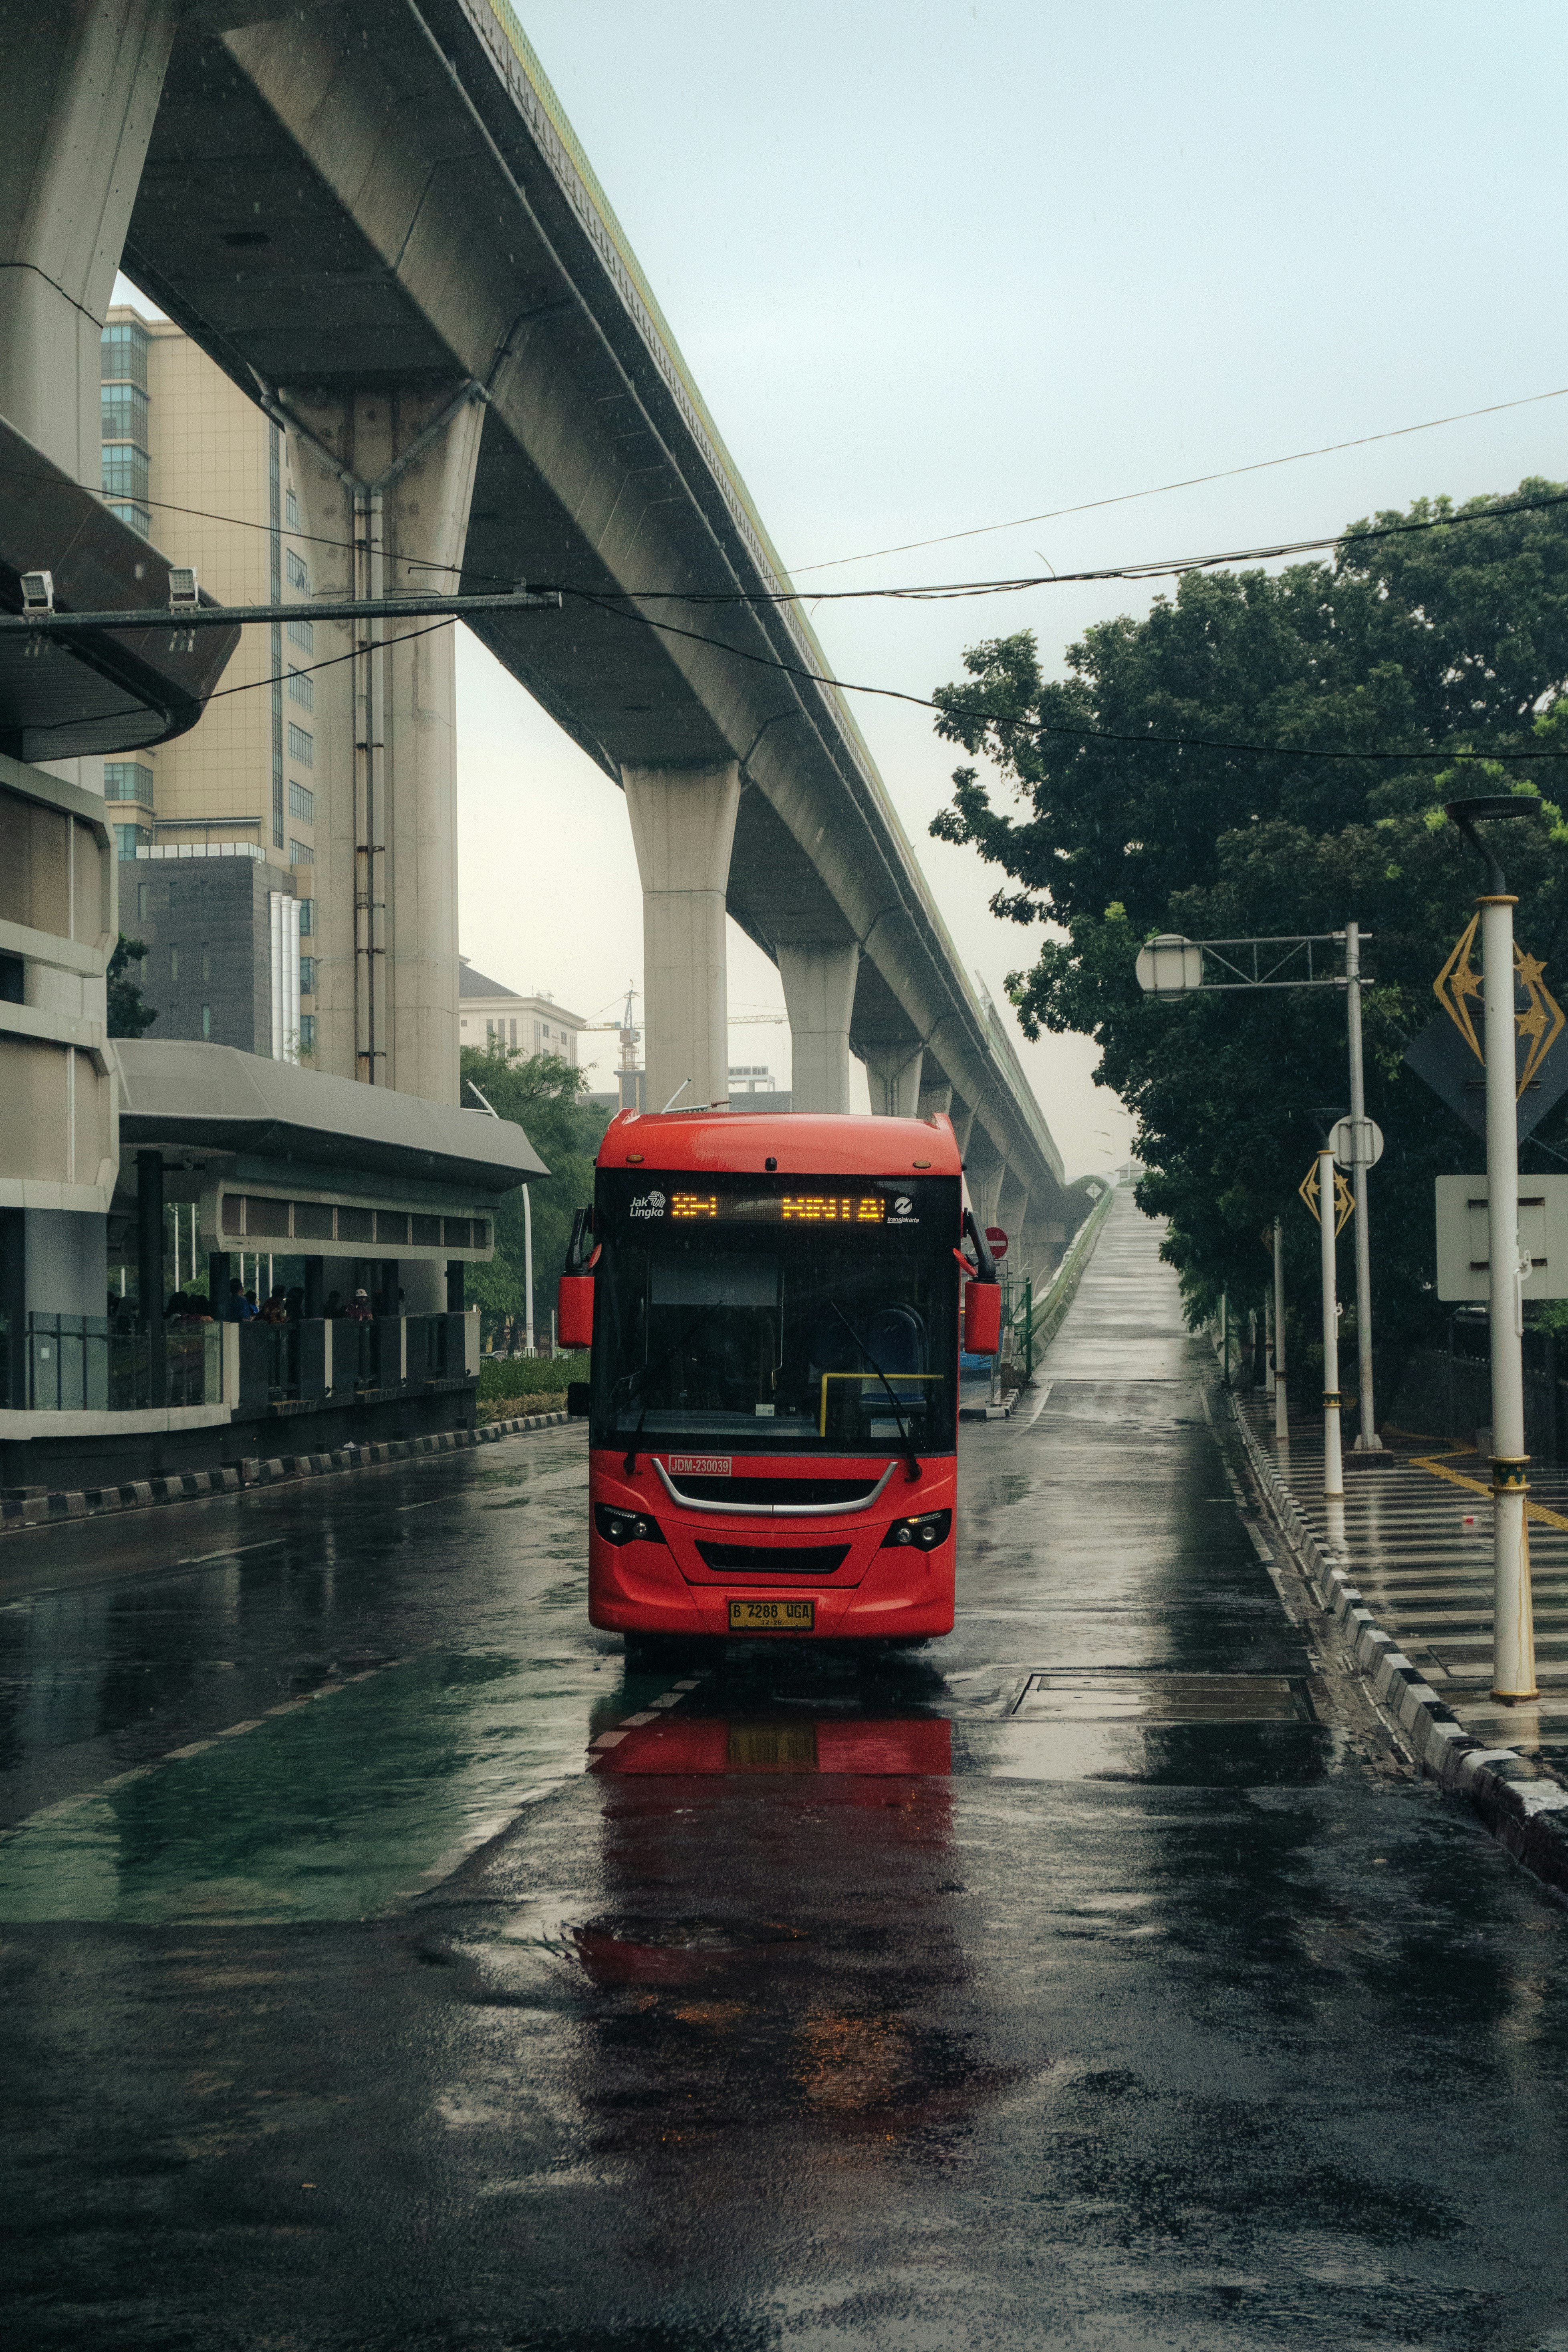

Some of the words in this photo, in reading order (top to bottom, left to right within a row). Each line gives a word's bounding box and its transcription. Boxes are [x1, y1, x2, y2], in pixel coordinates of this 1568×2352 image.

[630, 1197, 648, 1207] Jak
[629, 1207, 664, 1219] Lingko
[672, 1459, 728, 1472] JDM-230039
[734, 1604, 741, 1618] B
[747, 1604, 778, 1618] 7288
[786, 1604, 809, 1618] UGA
